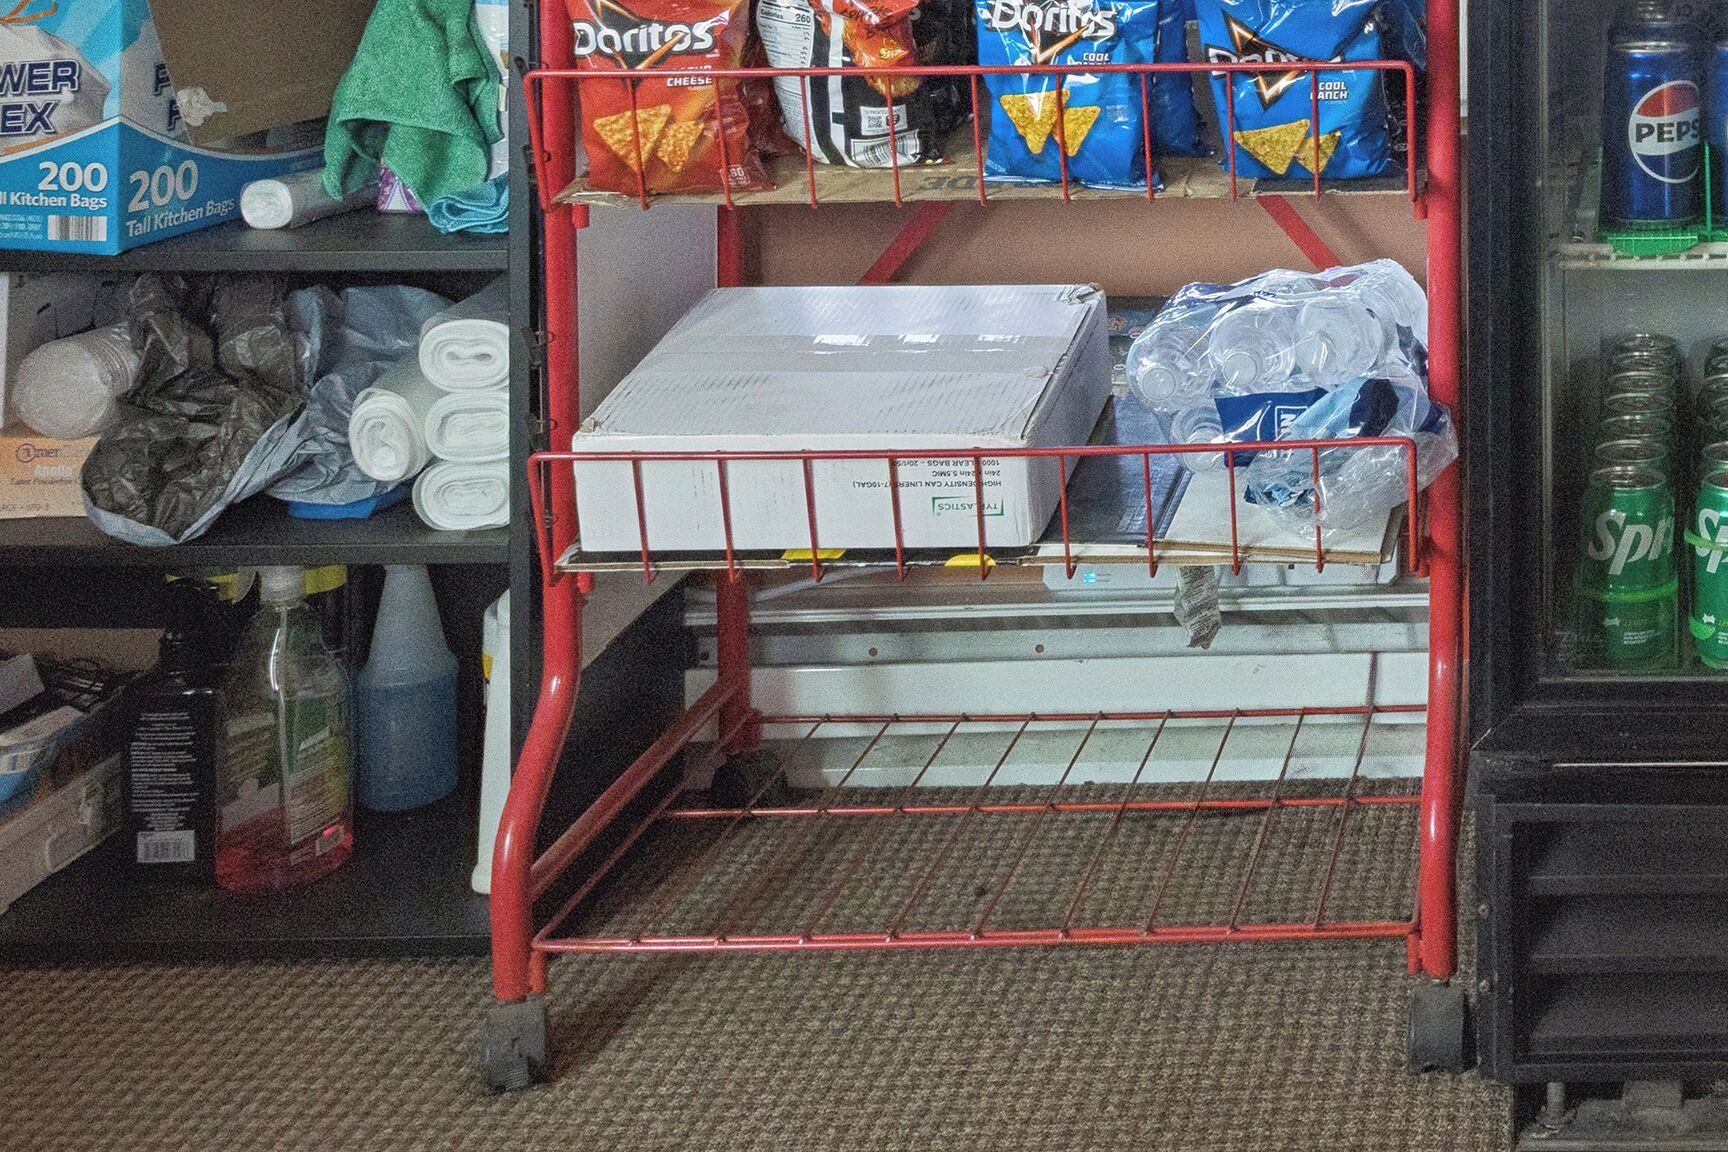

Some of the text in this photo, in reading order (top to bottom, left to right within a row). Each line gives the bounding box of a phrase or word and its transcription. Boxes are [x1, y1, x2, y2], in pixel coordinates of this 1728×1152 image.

[760, 8, 812, 25] Calories 260
[573, 22, 714, 55] Doritos
[1083, 52, 1110, 61] COOL
[0, 60, 80, 95] WER
[667, 77, 713, 87] CHEESE
[1318, 81, 1347, 91] COOL
[0, 101, 56, 135] EX
[1635, 122, 1698, 144] PEPS
[38, 161, 109, 192] 200
[127, 159, 199, 213] 200
[6, 192, 67, 207] Kitchen
[70, 193, 108, 210] Bags
[126, 197, 235, 238] Tall Kitchen Bags
